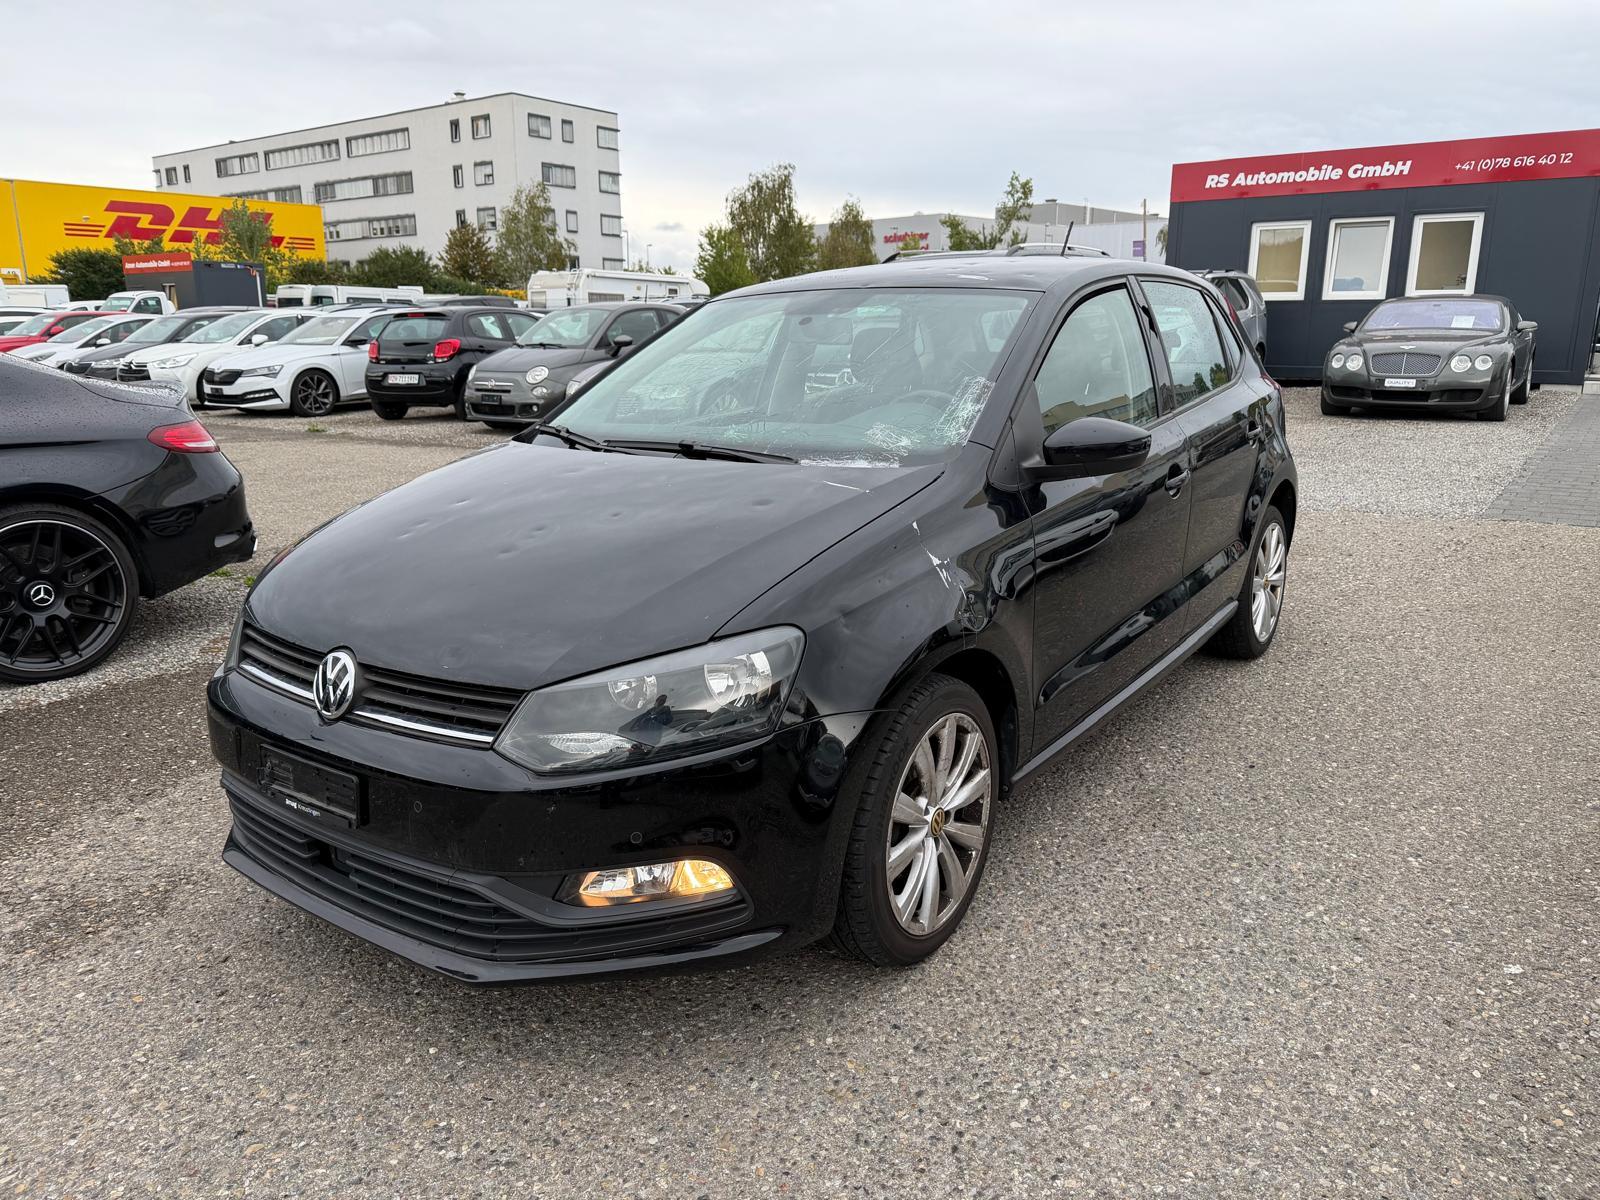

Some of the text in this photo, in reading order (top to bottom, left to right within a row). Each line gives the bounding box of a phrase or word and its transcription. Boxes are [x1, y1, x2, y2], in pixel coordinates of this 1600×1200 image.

[1204, 159, 1413, 189] RS Automobile GmbH
[1455, 152, 1574, 172] +41 (0)78 616 40 12
